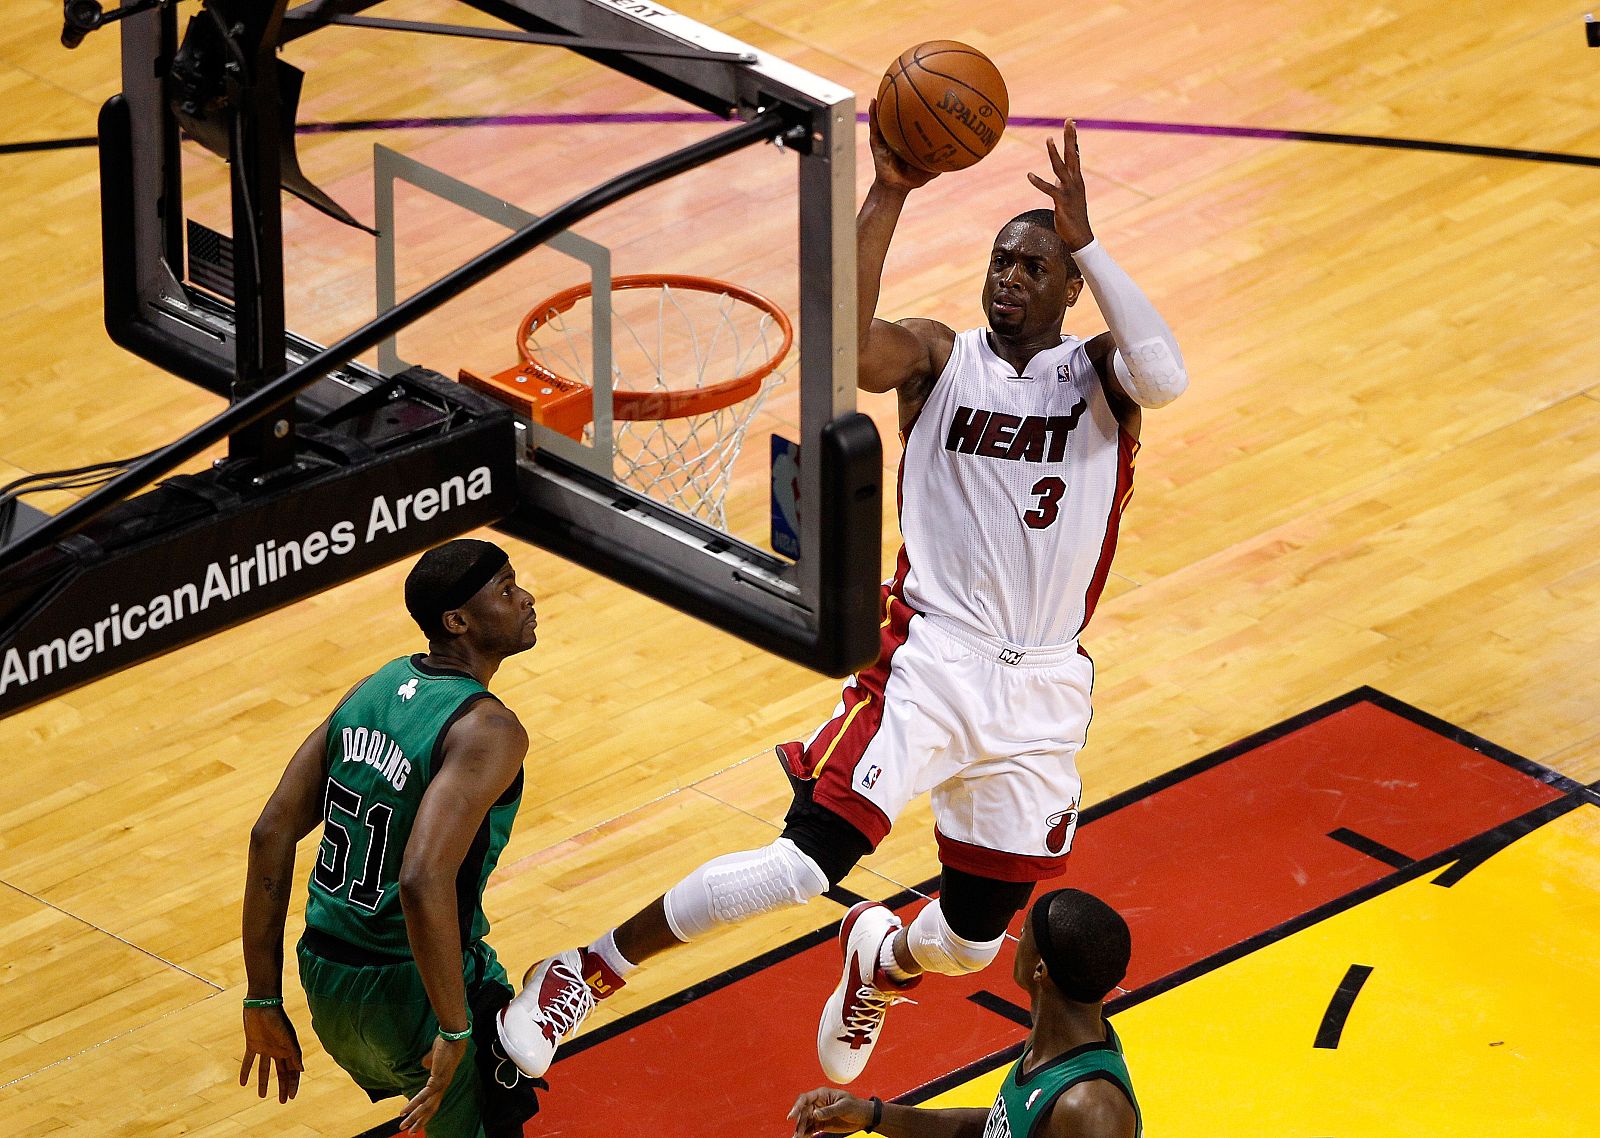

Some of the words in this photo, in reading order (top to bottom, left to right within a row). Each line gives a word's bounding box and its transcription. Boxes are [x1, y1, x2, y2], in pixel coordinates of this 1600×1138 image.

[944, 397, 1088, 463] HEAT
[1022, 475, 1068, 531] 3
[0, 520, 356, 695] AmericanAirlines
[365, 466, 492, 543] Arena
[342, 727, 411, 791] DOOLING
[314, 776, 393, 911] 51
